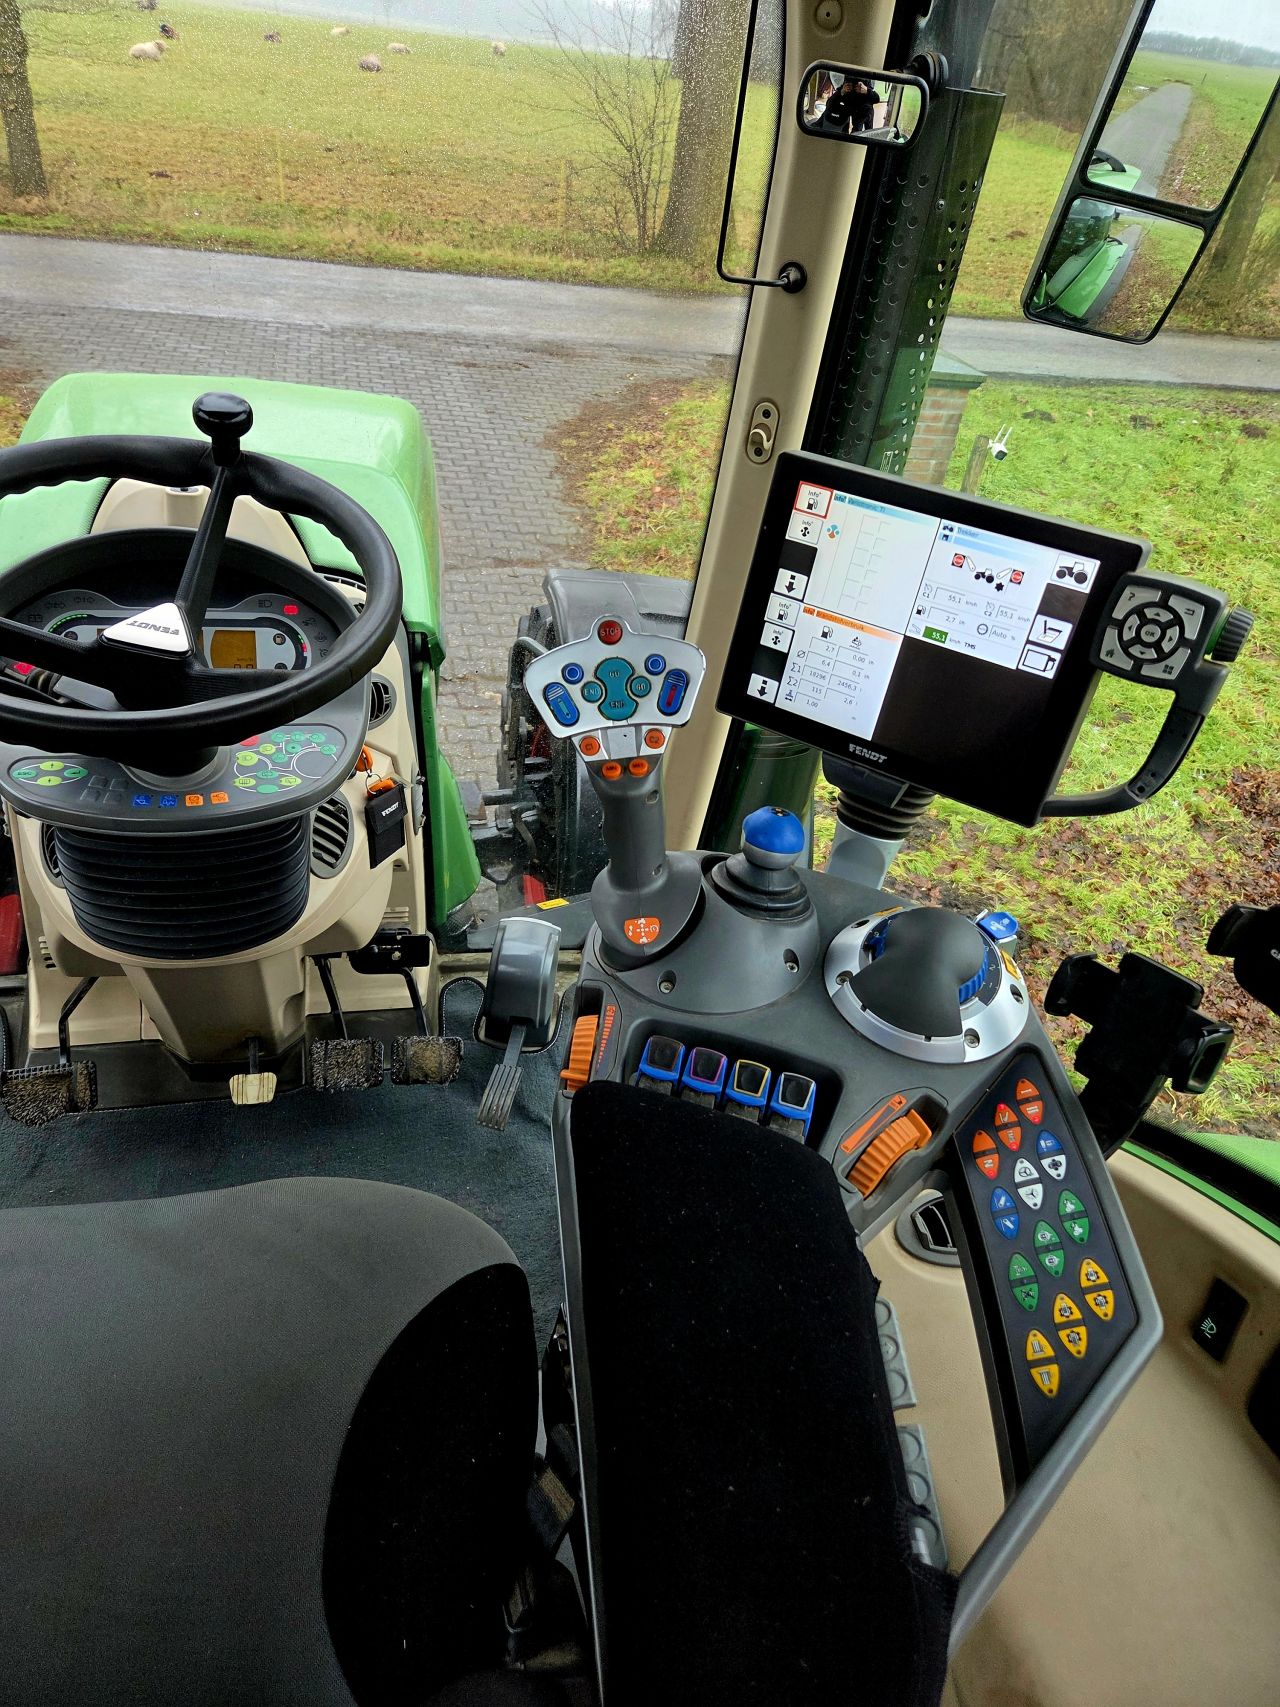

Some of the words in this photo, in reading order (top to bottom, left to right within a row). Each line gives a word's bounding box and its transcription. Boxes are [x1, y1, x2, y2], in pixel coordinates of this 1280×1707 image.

[126, 620, 180, 635] FENDT
[601, 626, 621, 637] STOP
[931, 631, 946, 642] 55,1
[1145, 630, 1155, 638] OK
[849, 743, 888, 763] FENDT
